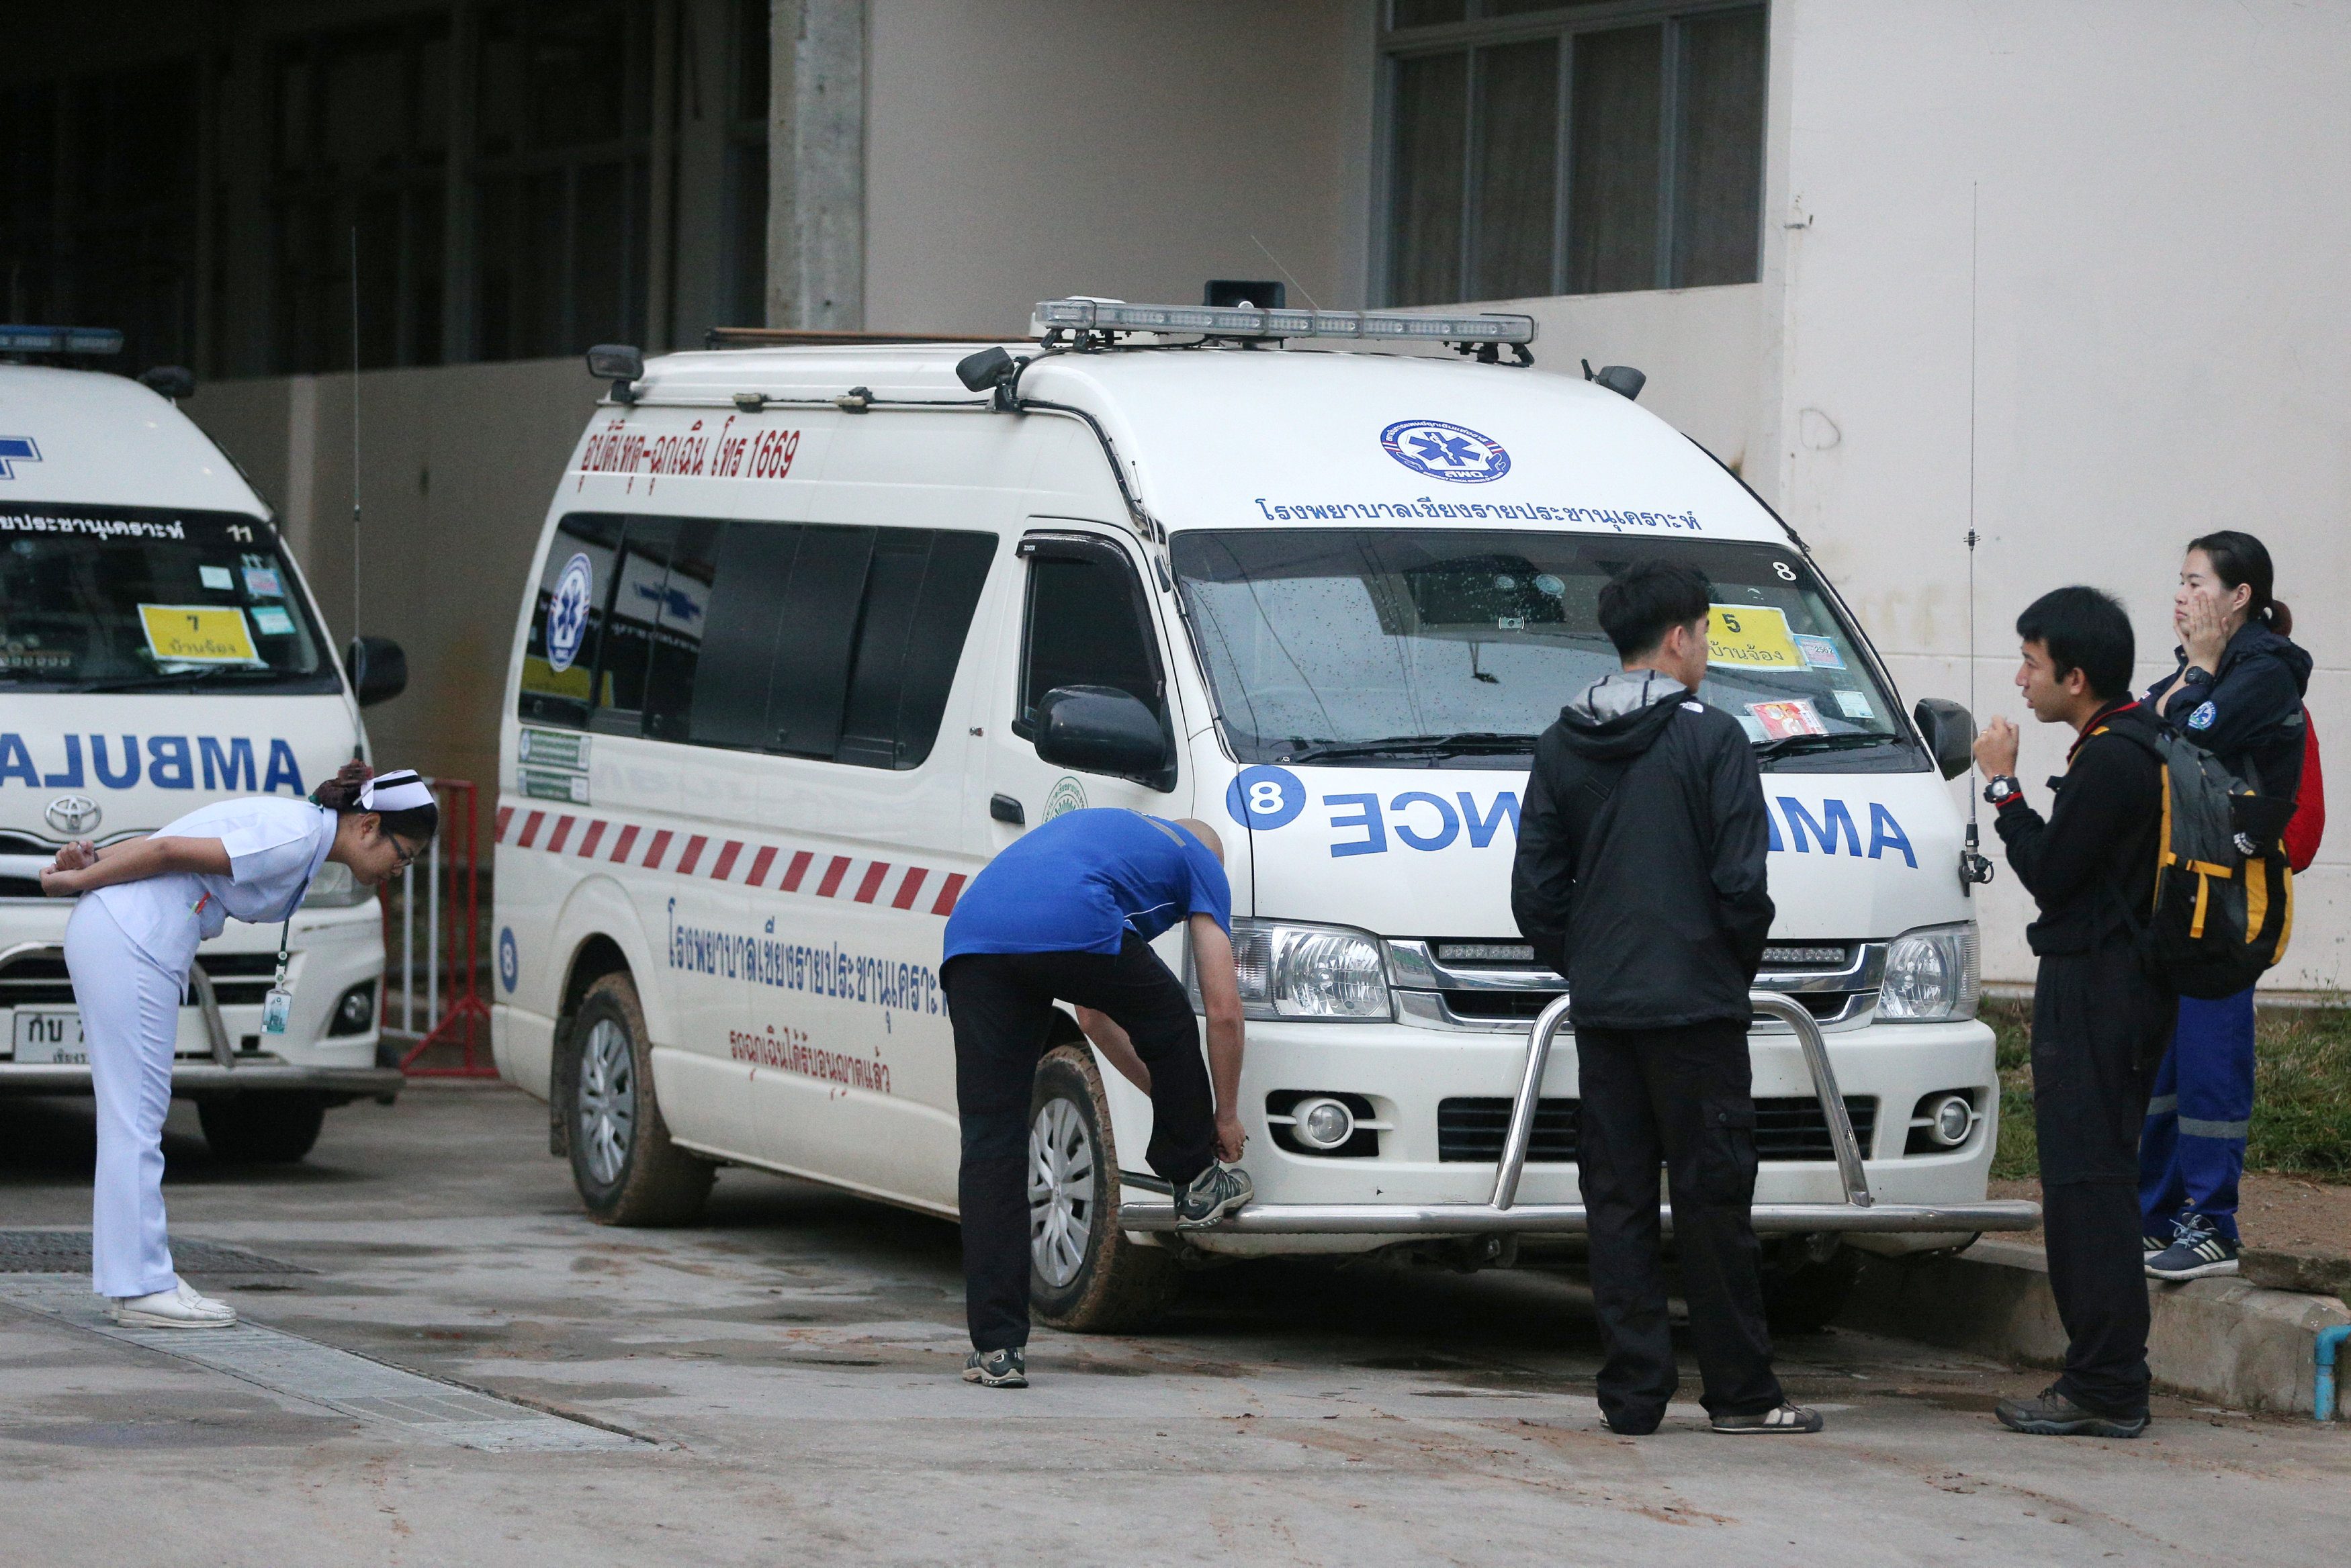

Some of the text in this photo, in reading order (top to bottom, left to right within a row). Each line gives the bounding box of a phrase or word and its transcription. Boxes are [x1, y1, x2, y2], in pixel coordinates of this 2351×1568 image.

[711, 415, 748, 477] โทร
[747, 430, 801, 479] 1669
[1255, 496, 1703, 532] โรงพยาบาลเชียงรายประชานุเคราะห์
[226, 524, 253, 543] 11
[1772, 561, 1797, 581] 8
[186, 614, 199, 633] 7
[1722, 613, 1741, 633] 5
[1709, 639, 1785, 661] บ้านจ้อง
[1249, 780, 1284, 815] 8
[503, 942, 515, 978] 8
[668, 896, 950, 1034] โรงพยาบาลเชียงรายประชานุเคราะ
